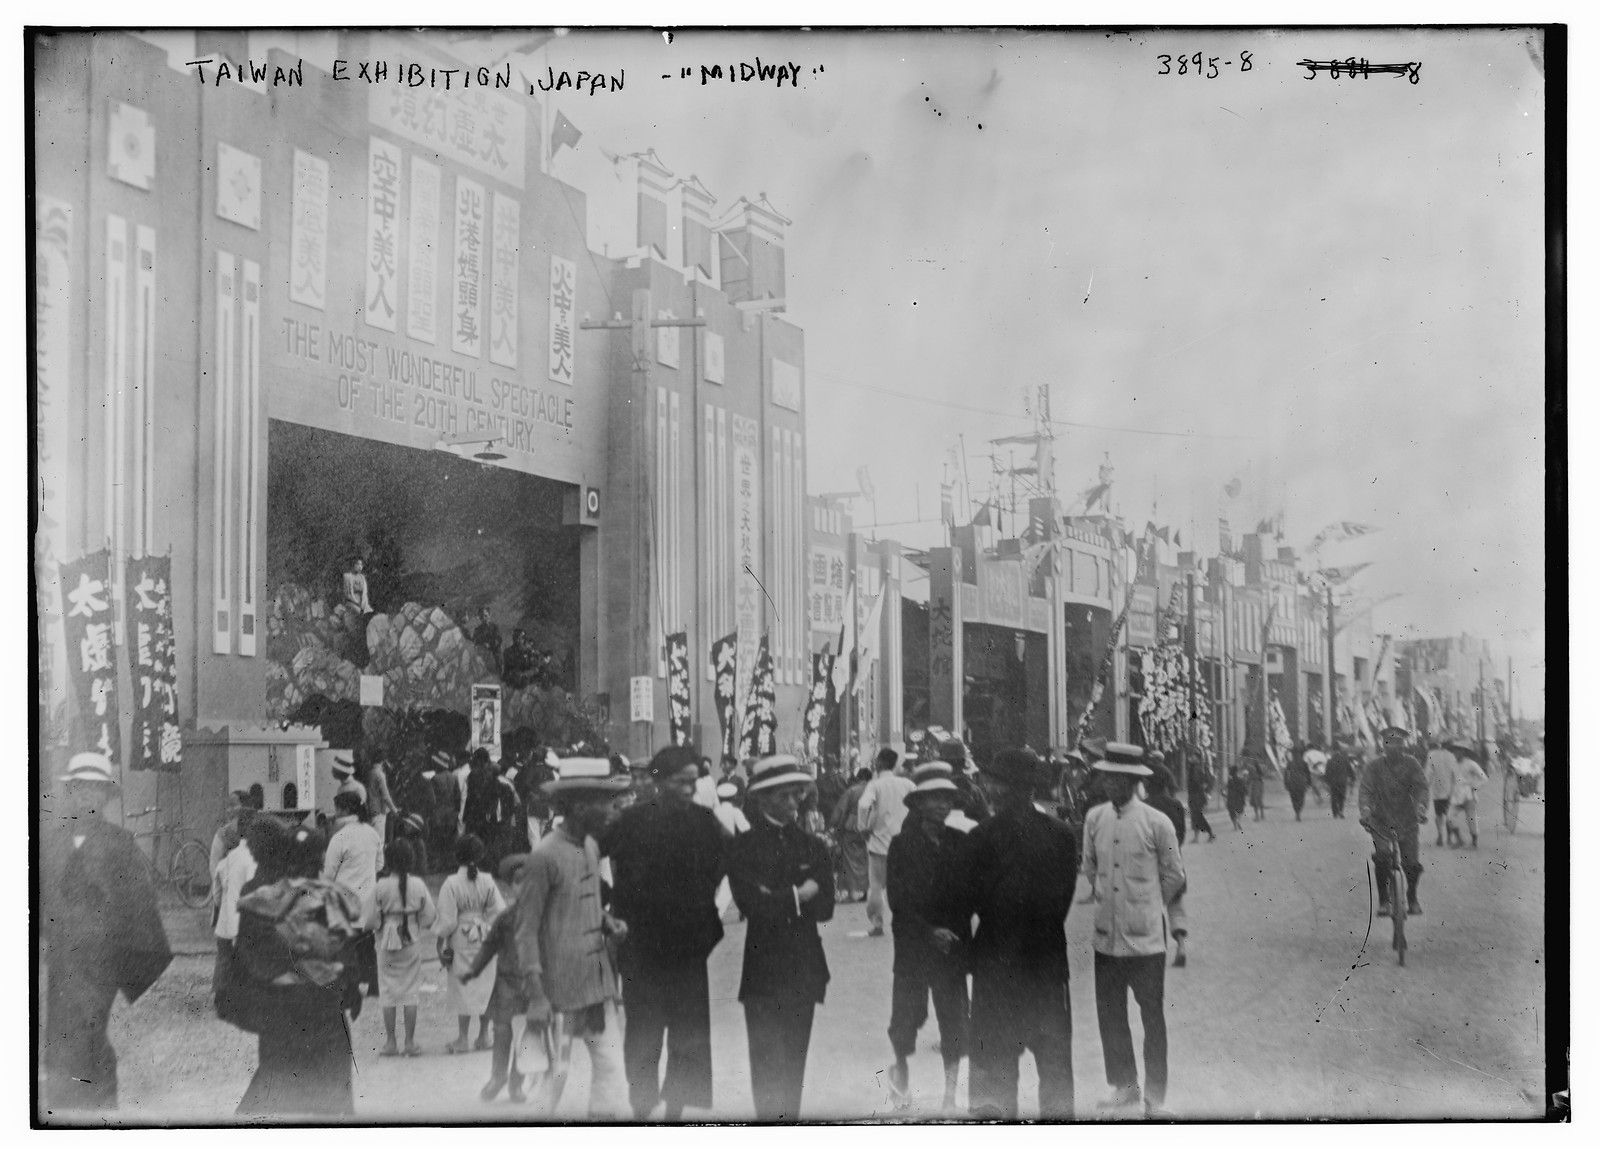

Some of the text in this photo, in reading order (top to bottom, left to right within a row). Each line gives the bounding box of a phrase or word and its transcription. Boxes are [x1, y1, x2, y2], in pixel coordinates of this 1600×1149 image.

[369, 149, 397, 319] 空中美人
[283, 317, 574, 429] THE MOST WONDERFUL SPECTACLE
[552, 263, 574, 379] 火中美人
[338, 374, 361, 410] OF
[369, 381, 405, 422] THE
[414, 393, 458, 433] 20TH
